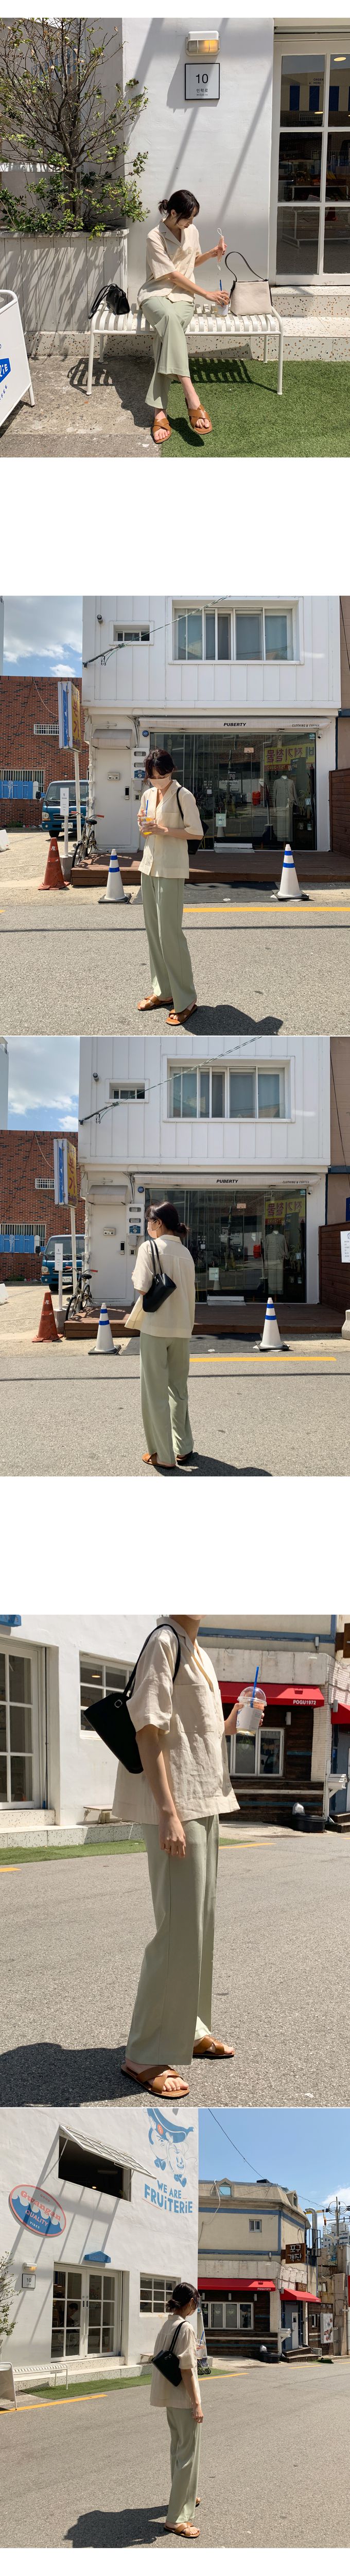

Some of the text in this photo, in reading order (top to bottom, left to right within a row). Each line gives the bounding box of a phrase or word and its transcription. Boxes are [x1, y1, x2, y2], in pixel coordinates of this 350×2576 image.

[196, 74, 208, 83] 10
[157, 2180, 182, 2199] WE ARE
[40, 2194, 50, 2202] GOOD
[21, 2190, 61, 2221] Gwangan
[25, 2209, 49, 2226] QUALITY
[30, 2221, 40, 2229] VIBES
[290, 2244, 301, 2253] 포구
[287, 2253, 302, 2261] 객잔
